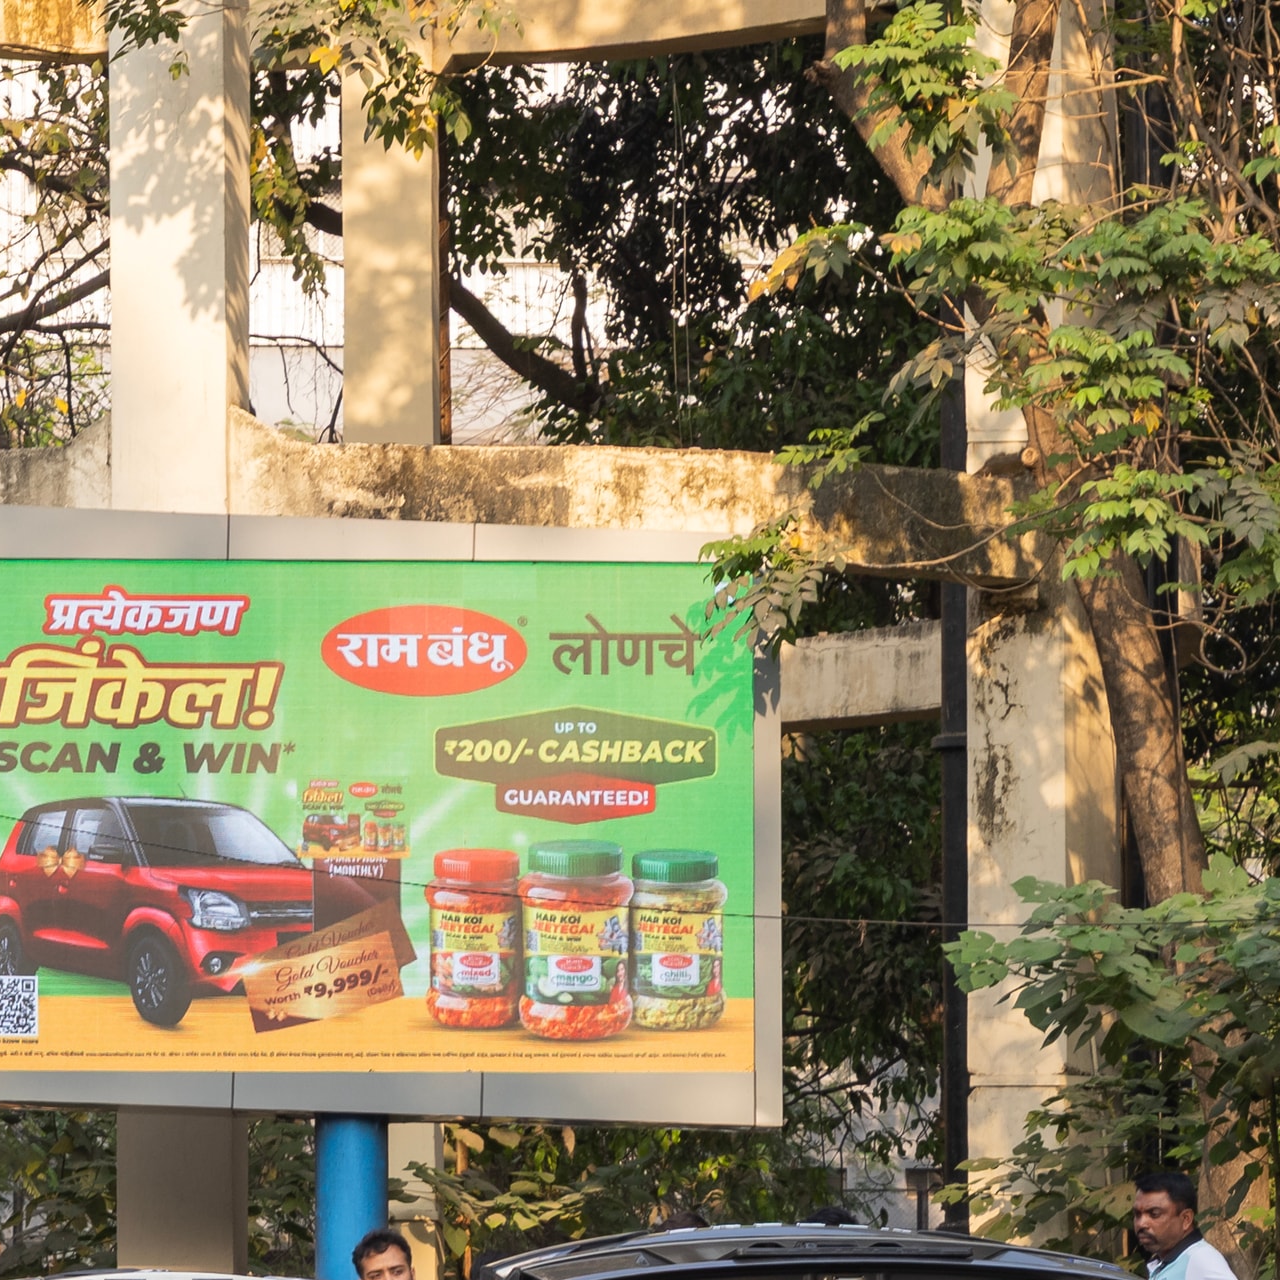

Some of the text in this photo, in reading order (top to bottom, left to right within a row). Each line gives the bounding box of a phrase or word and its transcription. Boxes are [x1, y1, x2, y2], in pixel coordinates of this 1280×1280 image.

[49, 590, 245, 631] प्रत्येकजण
[549, 613, 702, 676] लोणचे
[554, 722, 597, 734] UP TO
[132, 741, 166, 774] &
[444, 739, 534, 765] ₹200/-
[504, 789, 649, 807] GUARANTEED!
[329, 864, 384, 878] (MONTHLY)
[264, 964, 389, 1006] Worth ₹9,999/-
[275, 949, 378, 991] Gold Voucher
